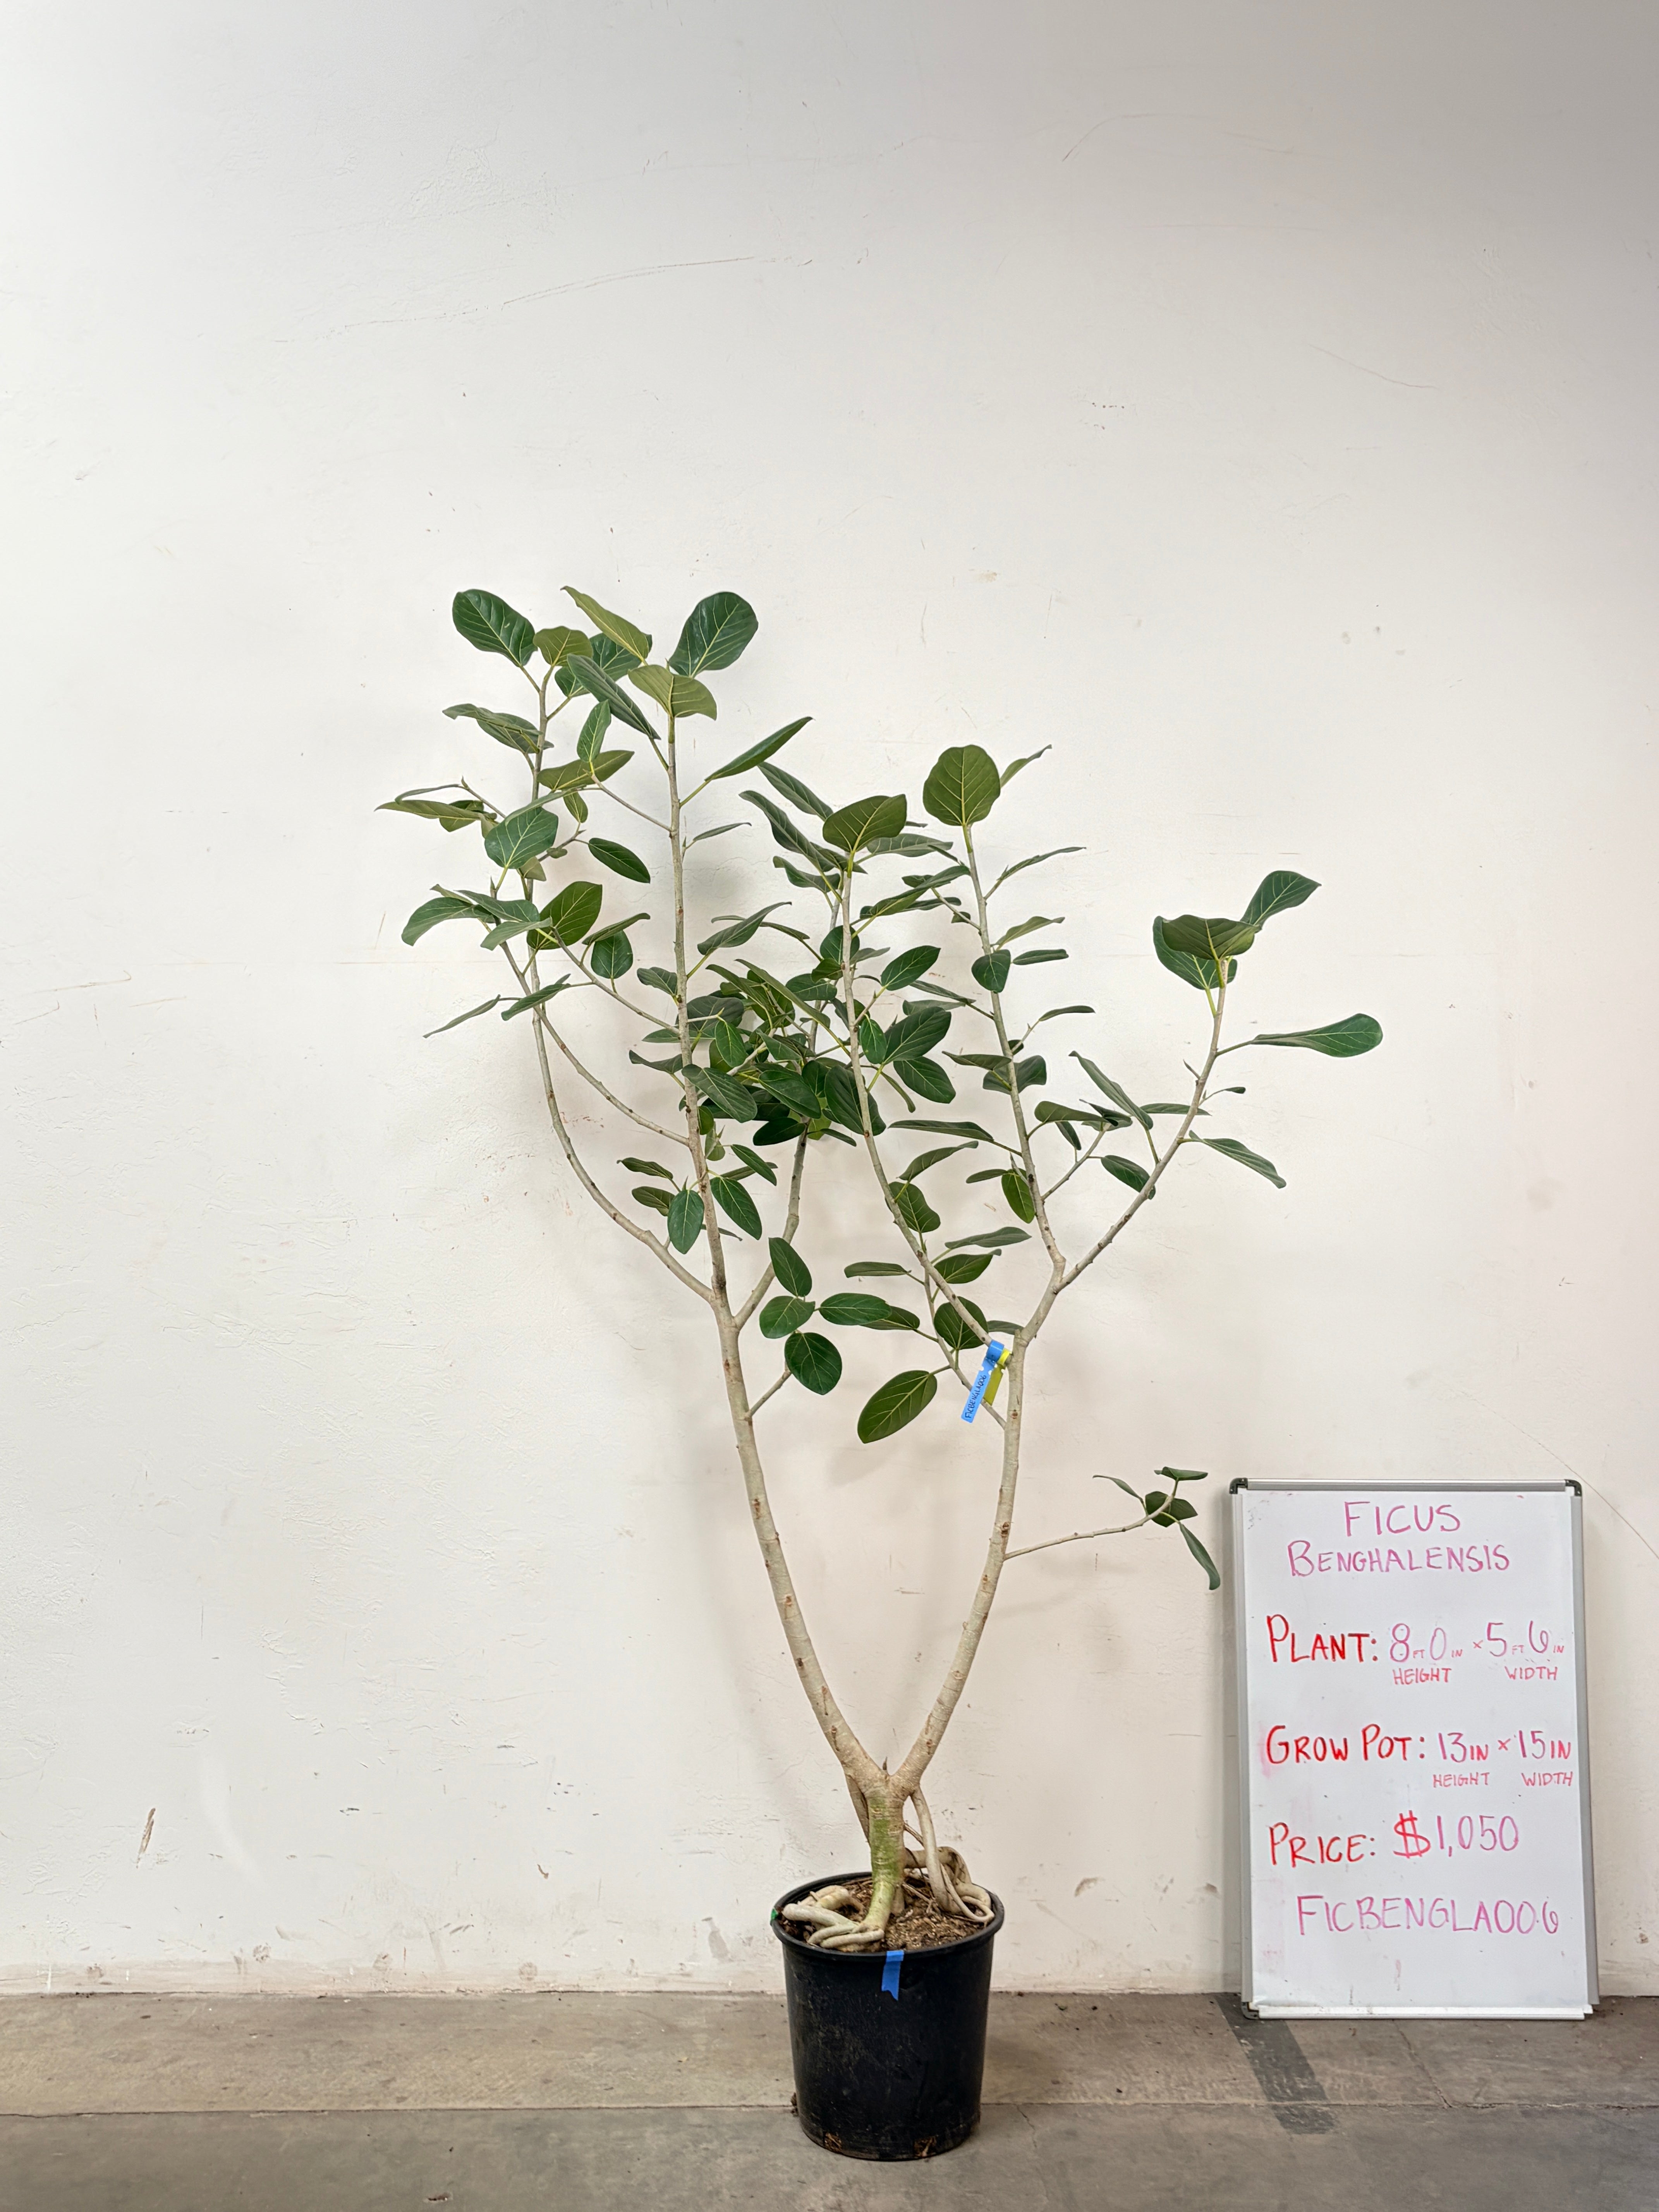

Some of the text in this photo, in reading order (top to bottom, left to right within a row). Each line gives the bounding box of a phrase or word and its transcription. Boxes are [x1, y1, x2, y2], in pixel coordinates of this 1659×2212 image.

[1345, 1501, 1461, 1537] FICUS
[1287, 1540, 1510, 1577] BENGHALENSIS
[1266, 1614, 1378, 1663] PLANT:
[1392, 1668, 1452, 1685] HEIGHT
[1504, 1666, 1558, 1681] WIDTH
[1266, 1725, 1349, 1764] GROW
[1361, 1723, 1425, 1761] POT:
[1433, 1772, 1490, 1788] HEIGHT
[1521, 1771, 1573, 1786] WIDTH
[1269, 1810, 1519, 1869] PRICE: $1,050
[1297, 1895, 1559, 1936] FICBENGLA006
